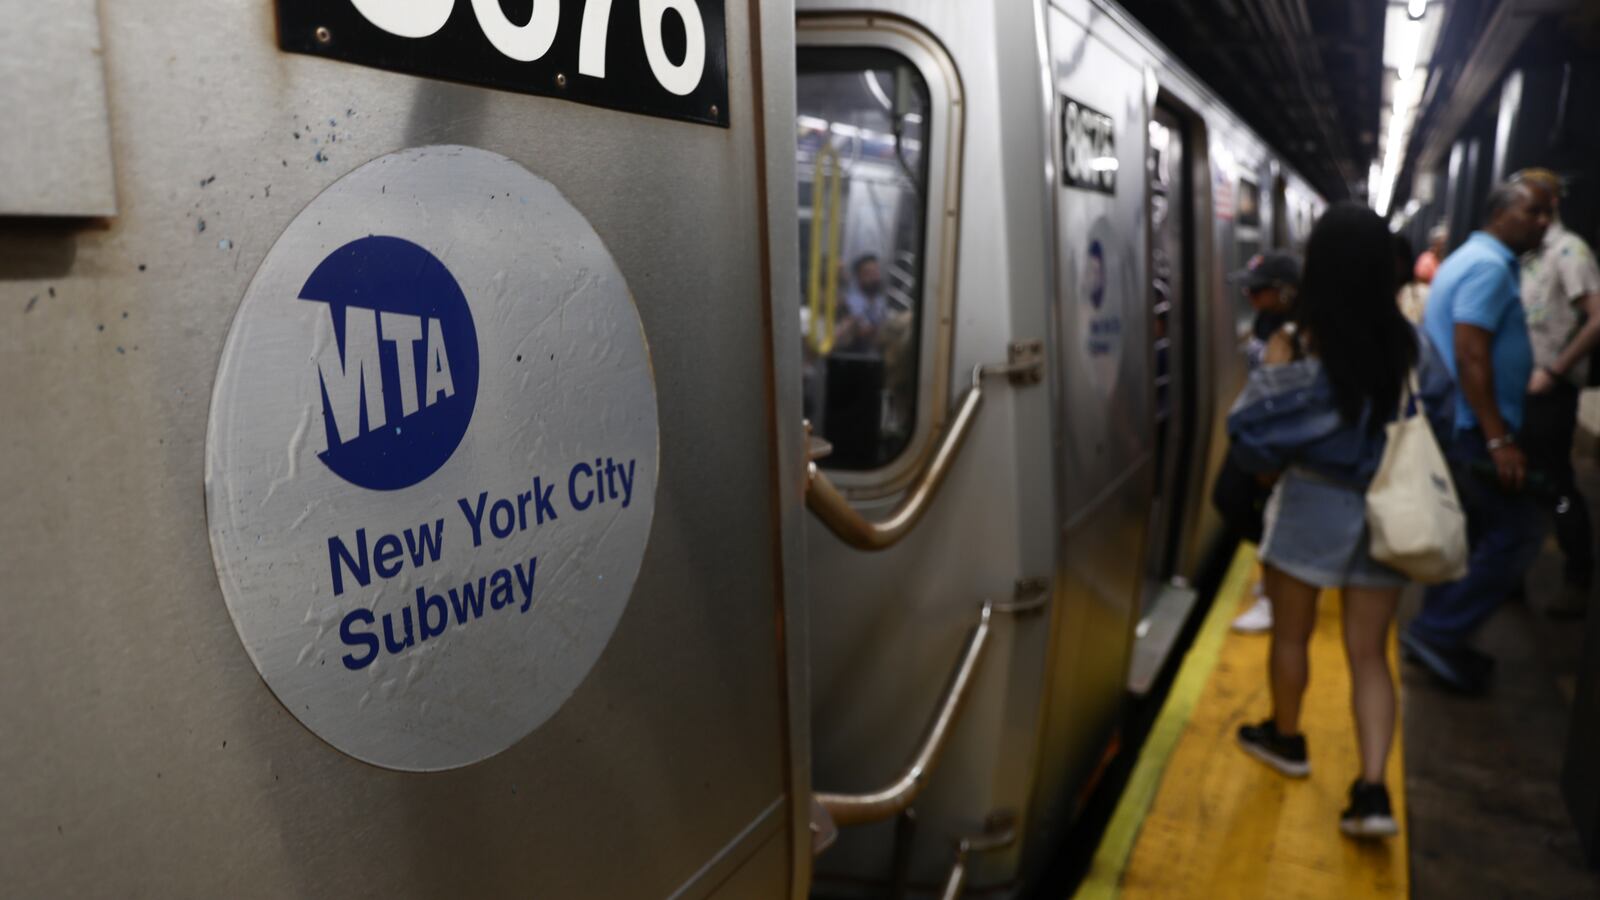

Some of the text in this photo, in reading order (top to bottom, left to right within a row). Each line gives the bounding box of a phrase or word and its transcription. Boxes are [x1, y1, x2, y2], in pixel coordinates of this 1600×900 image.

[310, 299, 456, 446] MTA
[327, 457, 636, 596] New York City
[338, 556, 538, 671] Subway
